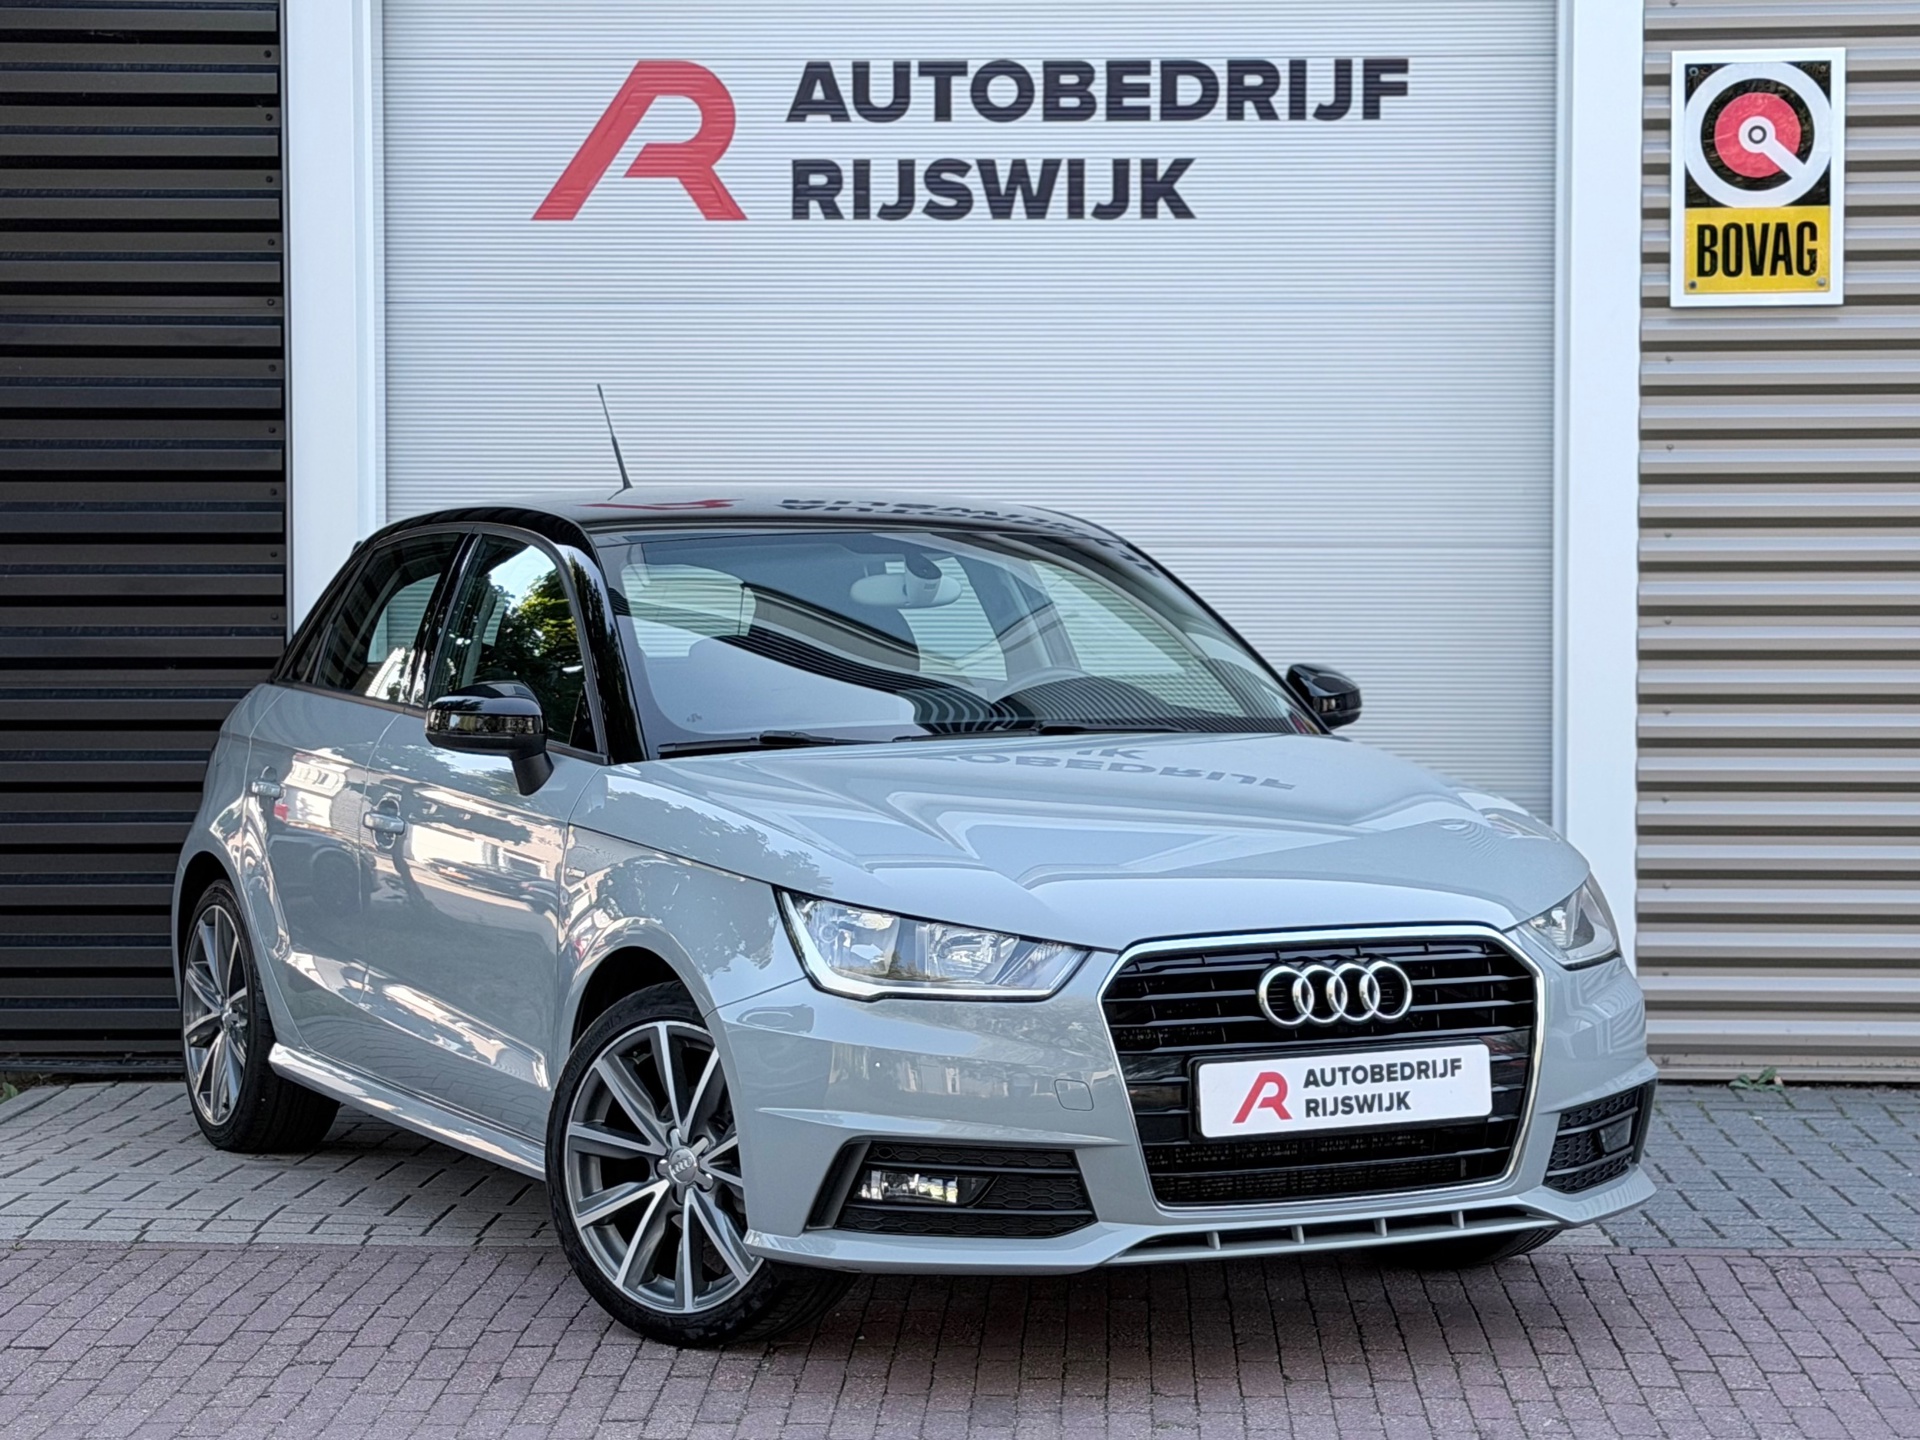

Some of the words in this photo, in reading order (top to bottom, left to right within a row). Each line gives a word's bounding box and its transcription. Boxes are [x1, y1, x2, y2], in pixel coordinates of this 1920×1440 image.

[785, 58, 1410, 123] AUTOBEDRIJF
[791, 157, 1197, 221] RIJSWIJK
[1696, 221, 1818, 278] BOVAG
[1303, 1057, 1463, 1089] AUTOBEDRIJF
[1305, 1091, 1412, 1119] RIJSWIJK
